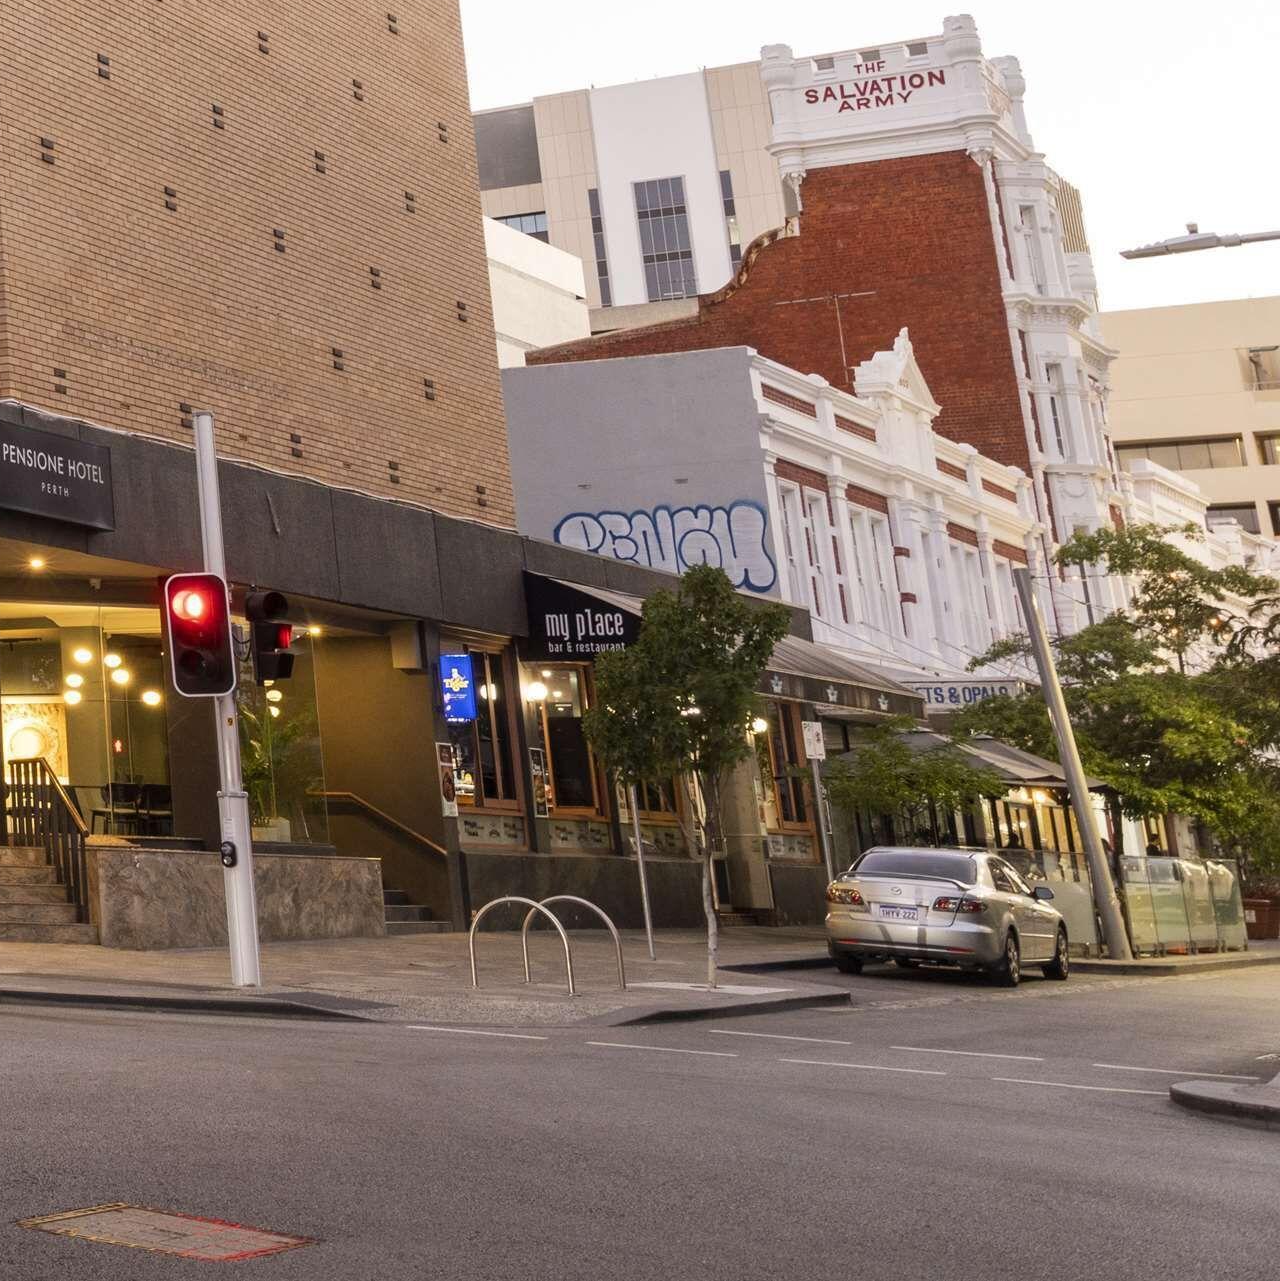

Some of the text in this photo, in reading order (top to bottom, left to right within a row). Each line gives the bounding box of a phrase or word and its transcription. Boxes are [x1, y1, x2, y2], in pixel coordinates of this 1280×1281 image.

[804, 70, 946, 105] SALVATION
[838, 91, 913, 113] ARMY
[2, 443, 105, 485] PENSIONE HOTEL
[41, 482, 70, 497] PERTH
[545, 609, 624, 641] my place
[548, 641, 563, 653] bar
[575, 642, 626, 653] restaurant
[947, 686, 960, 704] &
